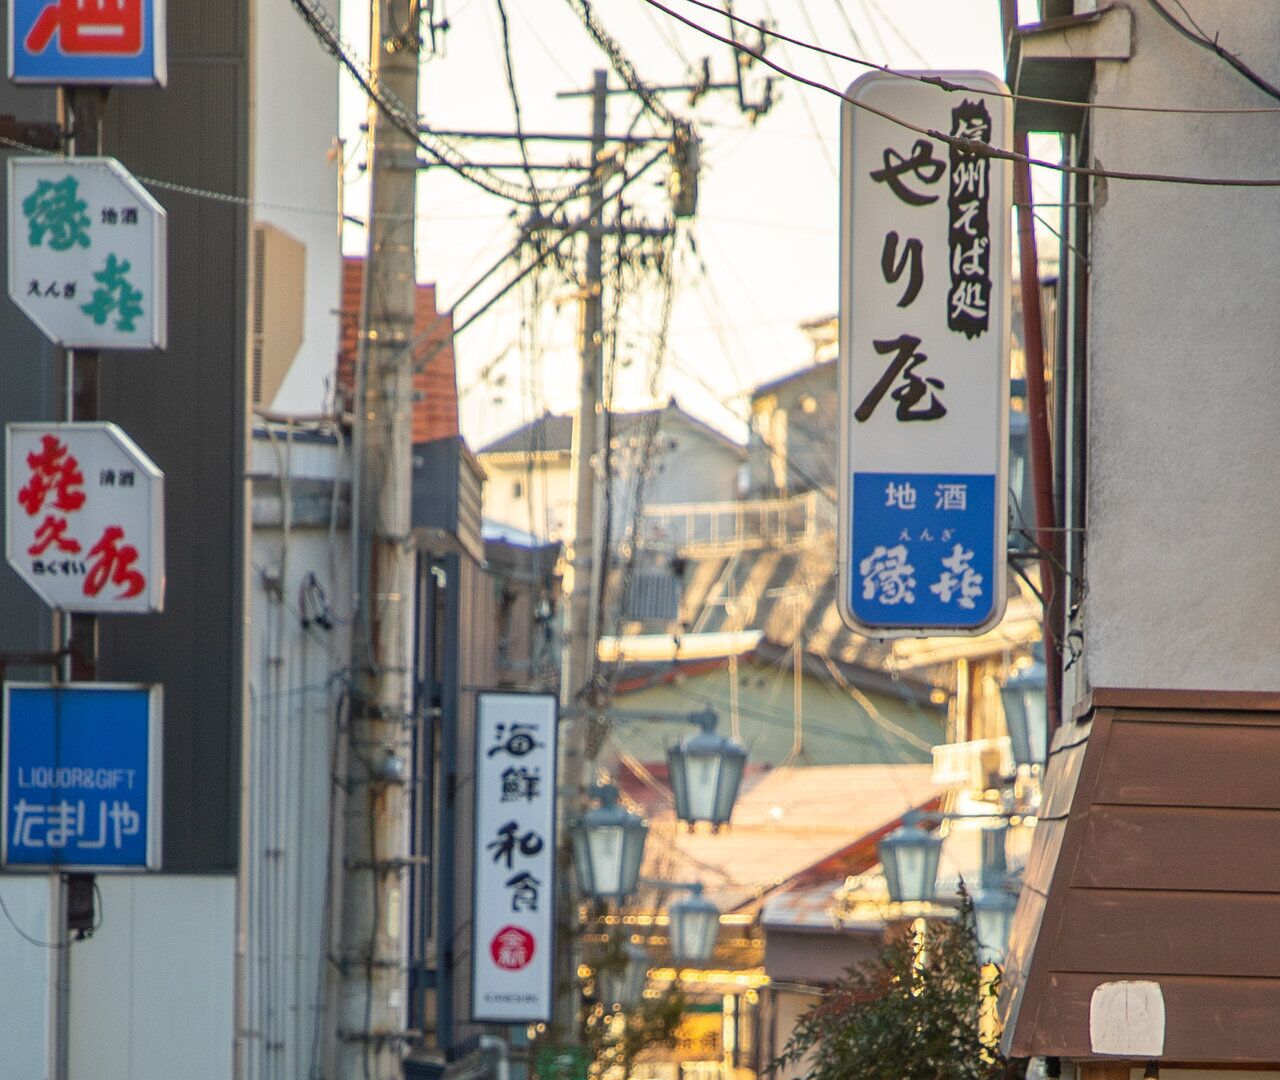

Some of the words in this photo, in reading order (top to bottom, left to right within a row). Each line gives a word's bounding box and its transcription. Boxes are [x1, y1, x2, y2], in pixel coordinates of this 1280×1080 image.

[101, 207, 138, 225] 地酒
[28, 279, 77, 299] えんぎ
[99, 468, 135, 487] 清酒
[884, 481, 968, 512] 地酒
[12, 798, 141, 849] たまりや
[487, 720, 546, 914] 海鮮和食
